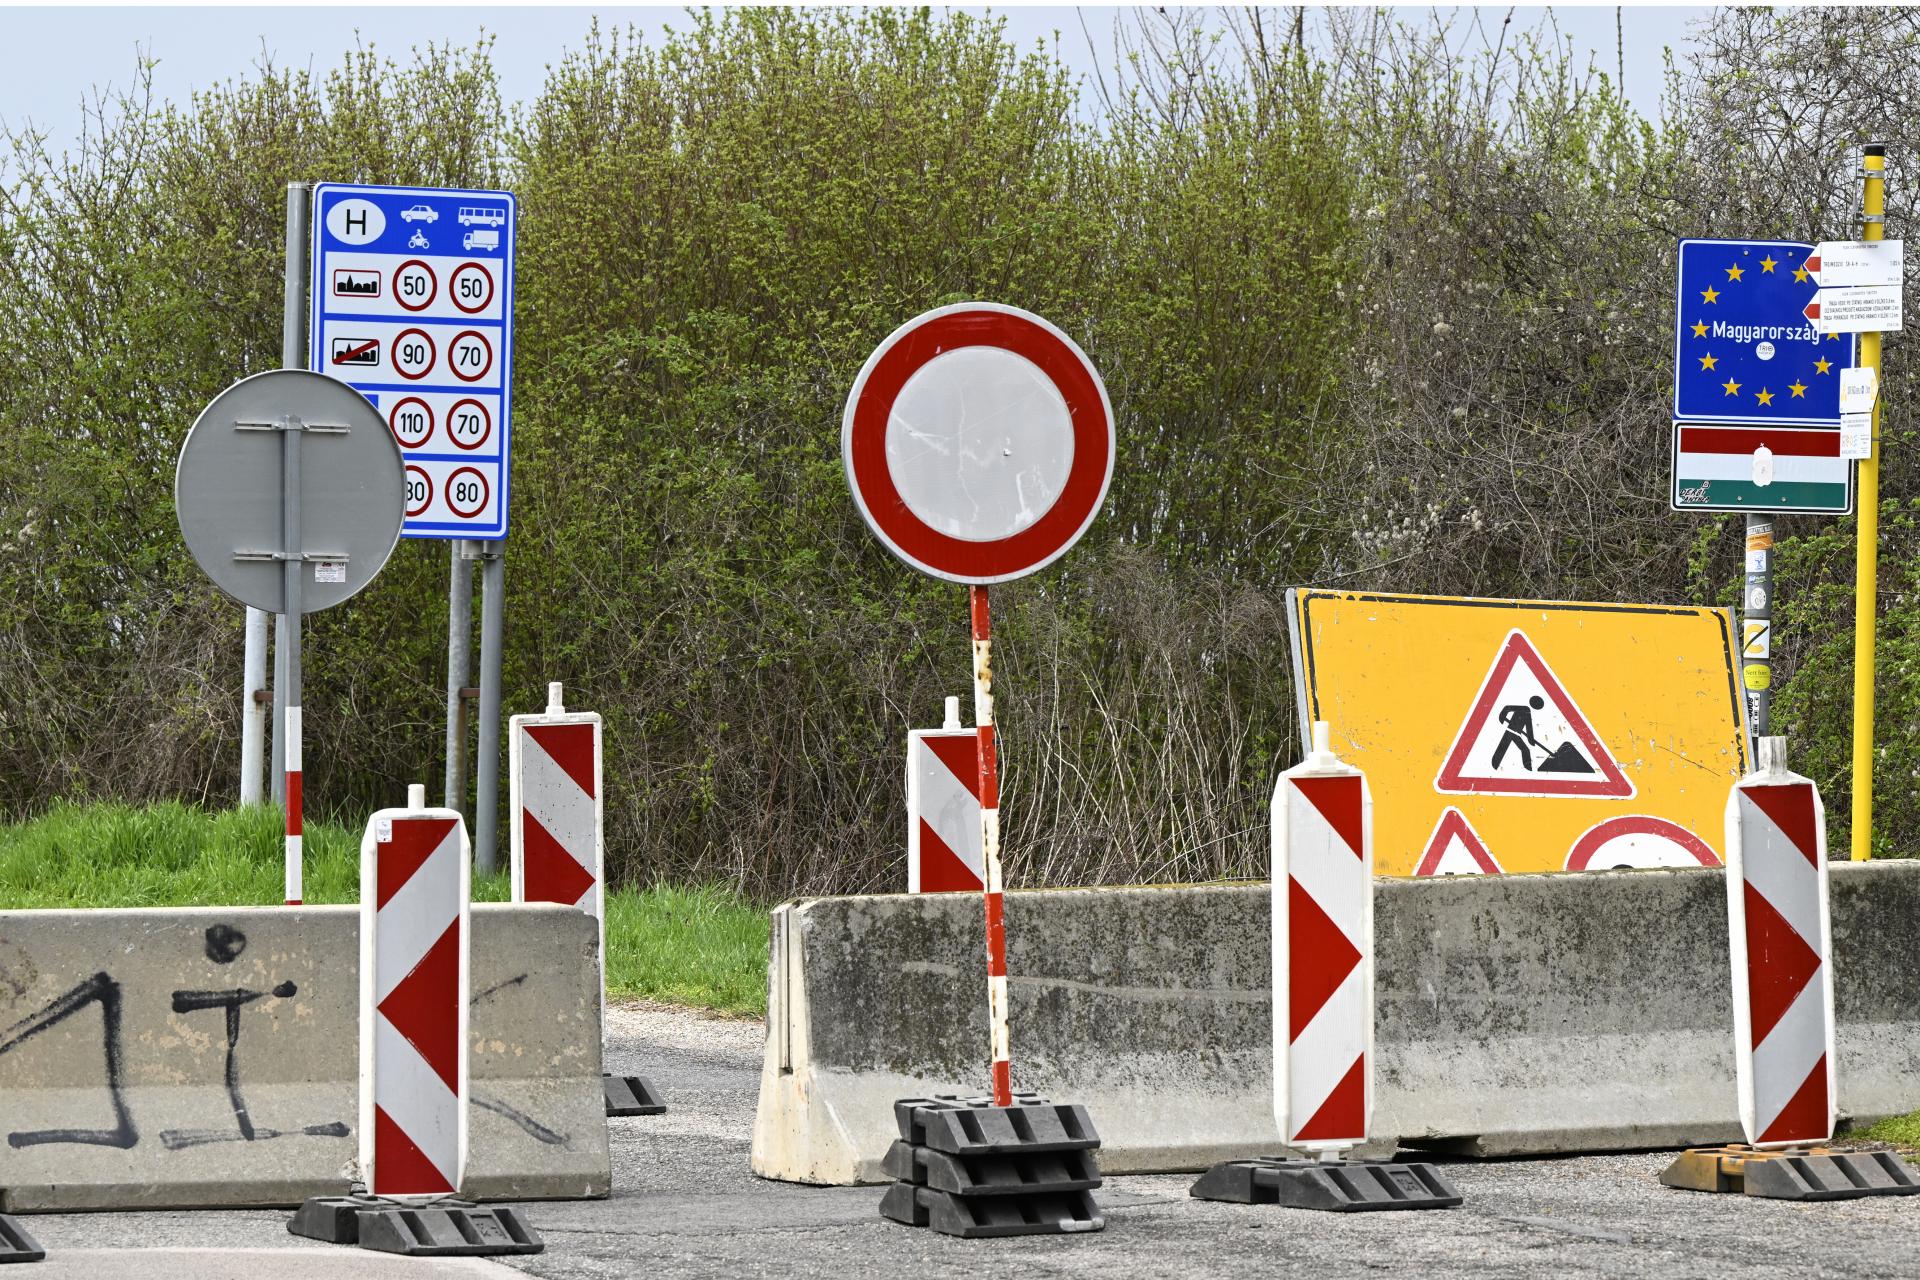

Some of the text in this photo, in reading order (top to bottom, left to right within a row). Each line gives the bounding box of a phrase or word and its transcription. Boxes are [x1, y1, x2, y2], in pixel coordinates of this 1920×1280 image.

[346, 208, 367, 236] H
[403, 275, 426, 296] 50
[461, 278, 483, 299] 50
[1712, 320, 1820, 346] Magyarország
[403, 344, 425, 365] 90
[459, 346, 481, 367] 70
[400, 413, 424, 434] 110
[457, 414, 480, 435] 70
[456, 482, 478, 503] 80
